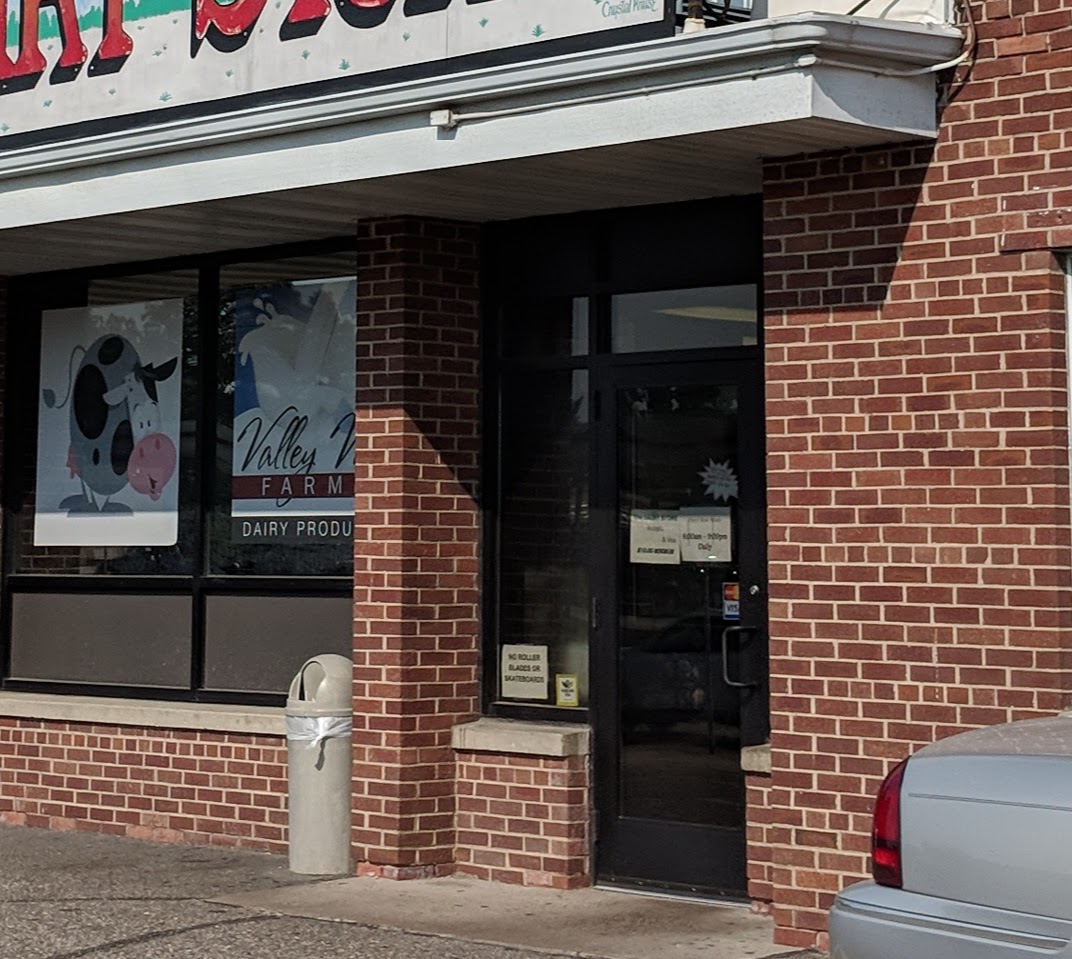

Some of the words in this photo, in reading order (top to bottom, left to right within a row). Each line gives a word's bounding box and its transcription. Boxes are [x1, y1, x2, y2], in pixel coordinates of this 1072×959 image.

[237, 406, 317, 507] Valley
[261, 475, 343, 496] FARM
[242, 521, 289, 537] DAIRY
[296, 520, 353, 537] PRODU
[508, 653, 517, 661] NO
[518, 653, 541, 662] ROLLER
[508, 664, 531, 672] BLADES
[504, 674, 545, 684] SKATEBOARDS
